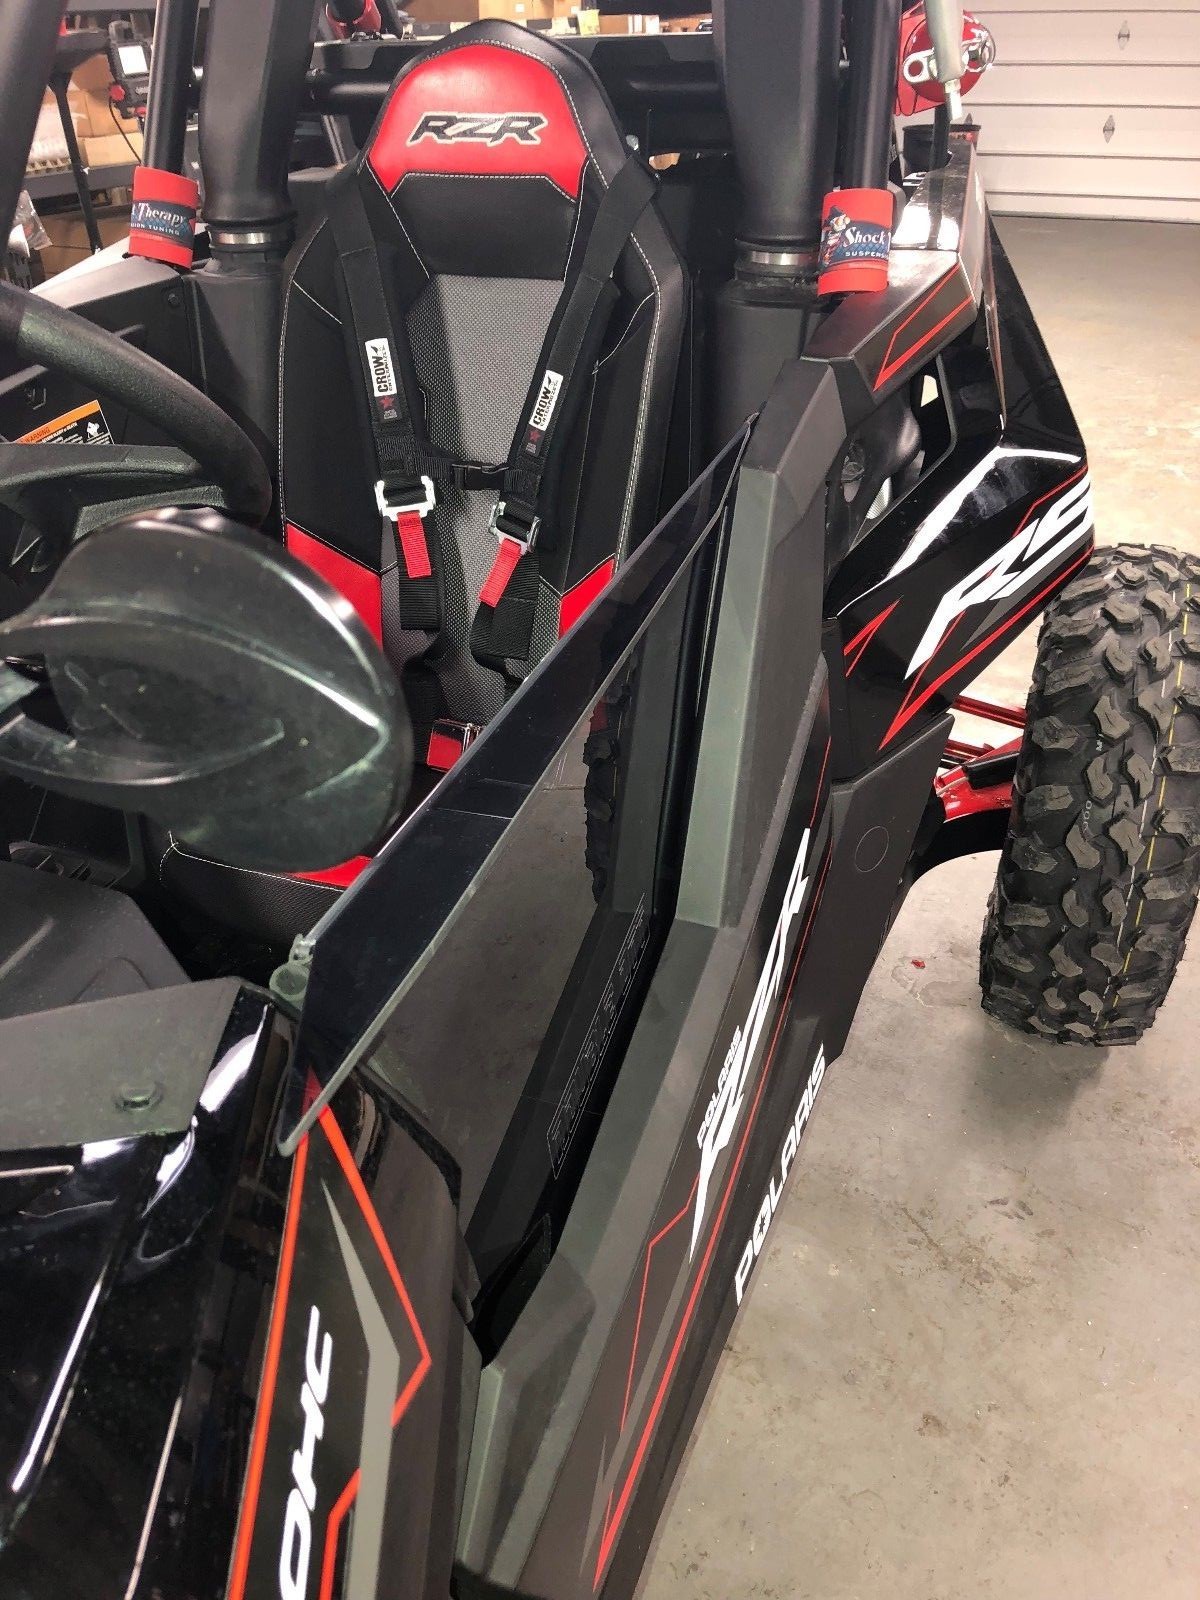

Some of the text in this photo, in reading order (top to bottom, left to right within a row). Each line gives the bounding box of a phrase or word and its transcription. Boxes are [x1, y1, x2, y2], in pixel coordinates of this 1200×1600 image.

[407, 112, 548, 147] RZR
[138, 203, 184, 228] Therapy
[149, 225, 180, 235] TUNING
[843, 227, 886, 247] Shock
[372, 355, 388, 393] CROW
[533, 386, 551, 425] CROW
[689, 828, 810, 1265] RZR
[696, 1025, 742, 1149] POLARIS
[734, 1043, 826, 1307] POLARIS
